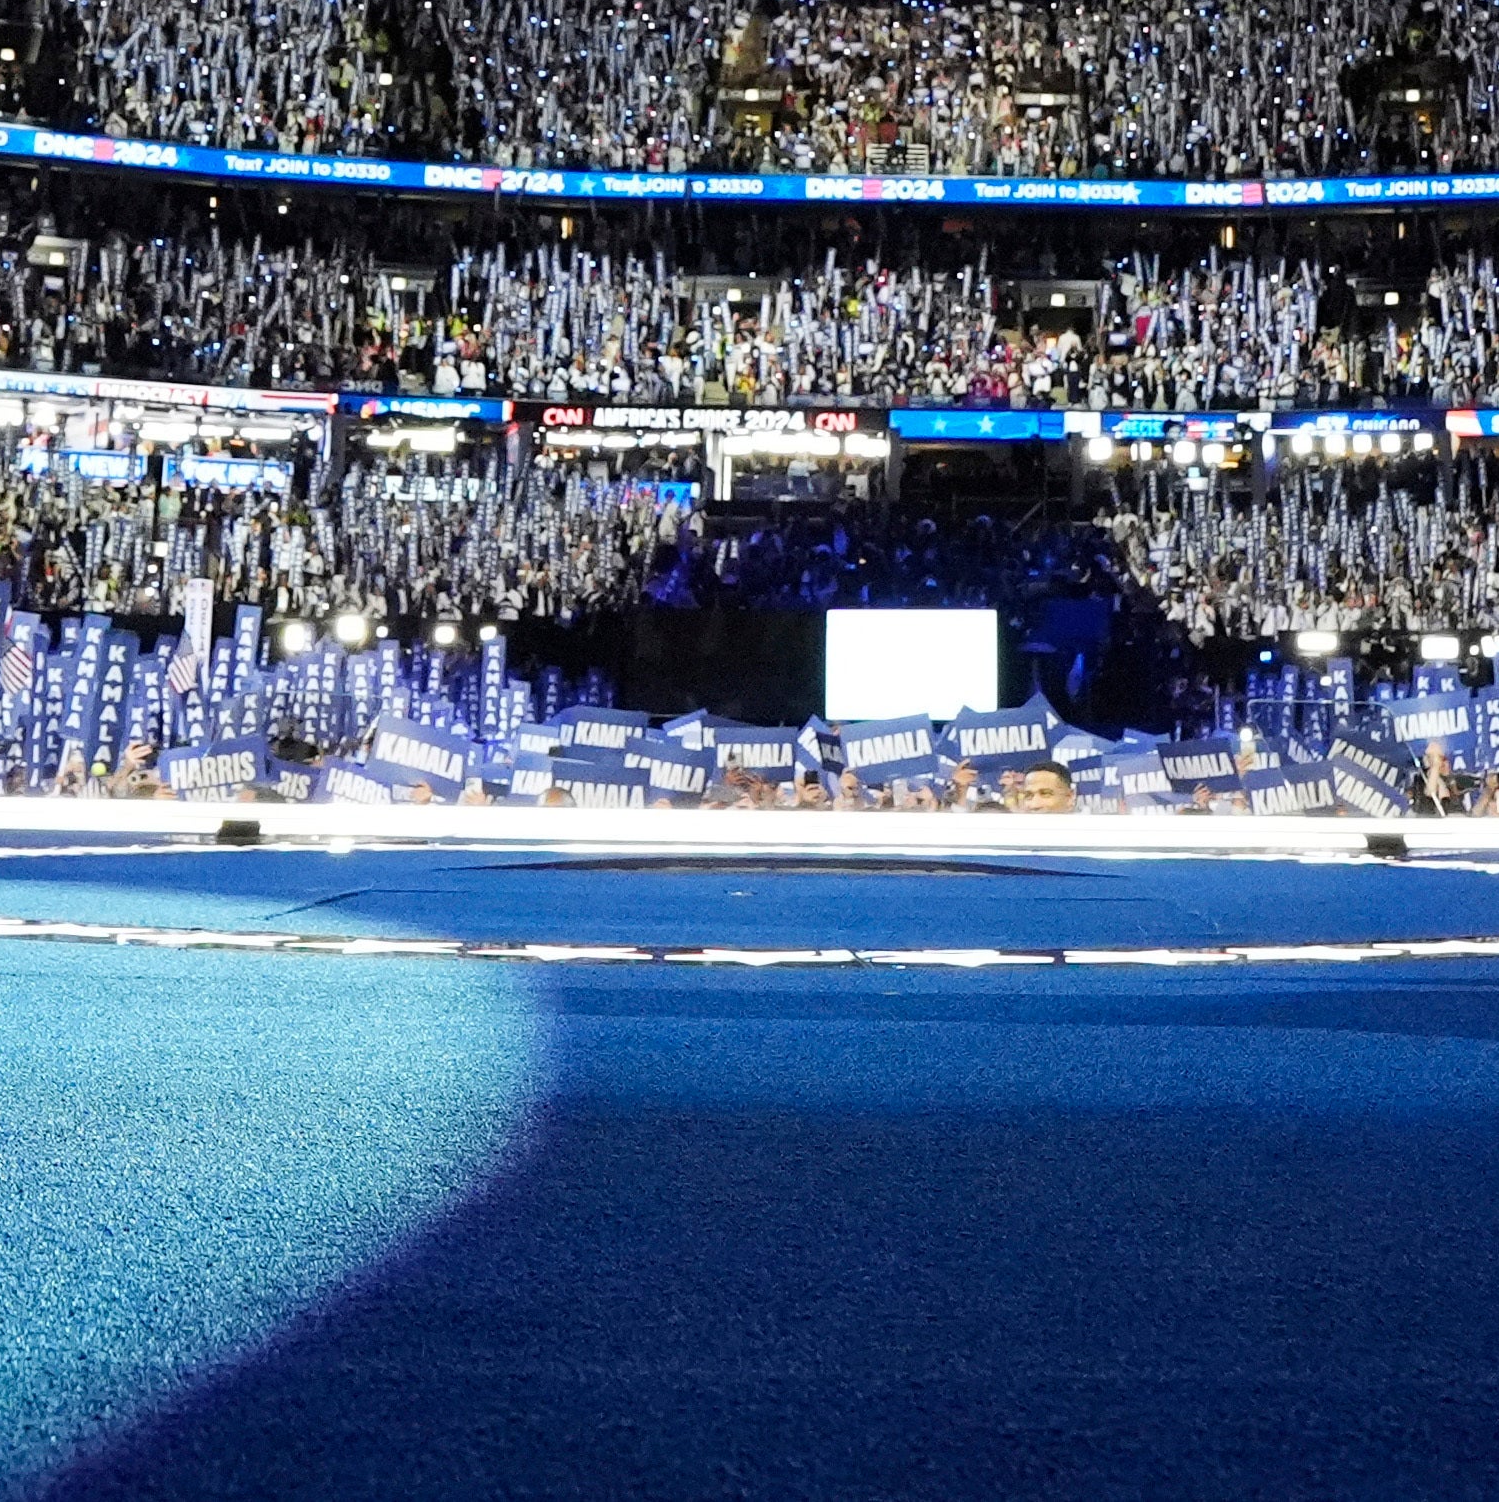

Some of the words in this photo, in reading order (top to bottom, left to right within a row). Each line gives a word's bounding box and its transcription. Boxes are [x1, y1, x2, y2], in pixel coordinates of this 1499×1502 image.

[34, 131, 94, 160] DNC
[112, 140, 179, 167] 2024
[225, 155, 264, 172] Text
[264, 158, 310, 175] JOIN
[312, 161, 332, 176] to
[424, 165, 483, 190] DNC
[805, 177, 863, 200] DNC
[881, 178, 946, 200] 2024
[1185, 182, 1243, 205] DNC
[1345, 182, 1382, 197] Text
[1384, 180, 1428, 196] JOIN
[1430, 181, 1450, 195] to
[543, 406, 584, 426] CNN
[815, 412, 857, 432] CNN
[65, 627, 103, 729] KAMALA
[484, 645, 500, 725] KAMALA
[94, 645, 126, 762] KAMALA
[959, 723, 1047, 757] KAMALA
[1393, 705, 1471, 743] KAMALA
[375, 731, 464, 783] KAMALA
[846, 728, 933, 769] KAMALA
[1162, 751, 1236, 781] KAMALA
[1327, 737, 1399, 789] KAMALA
[169, 750, 257, 791] HARRIS
[1251, 778, 1336, 816] KAMALA
